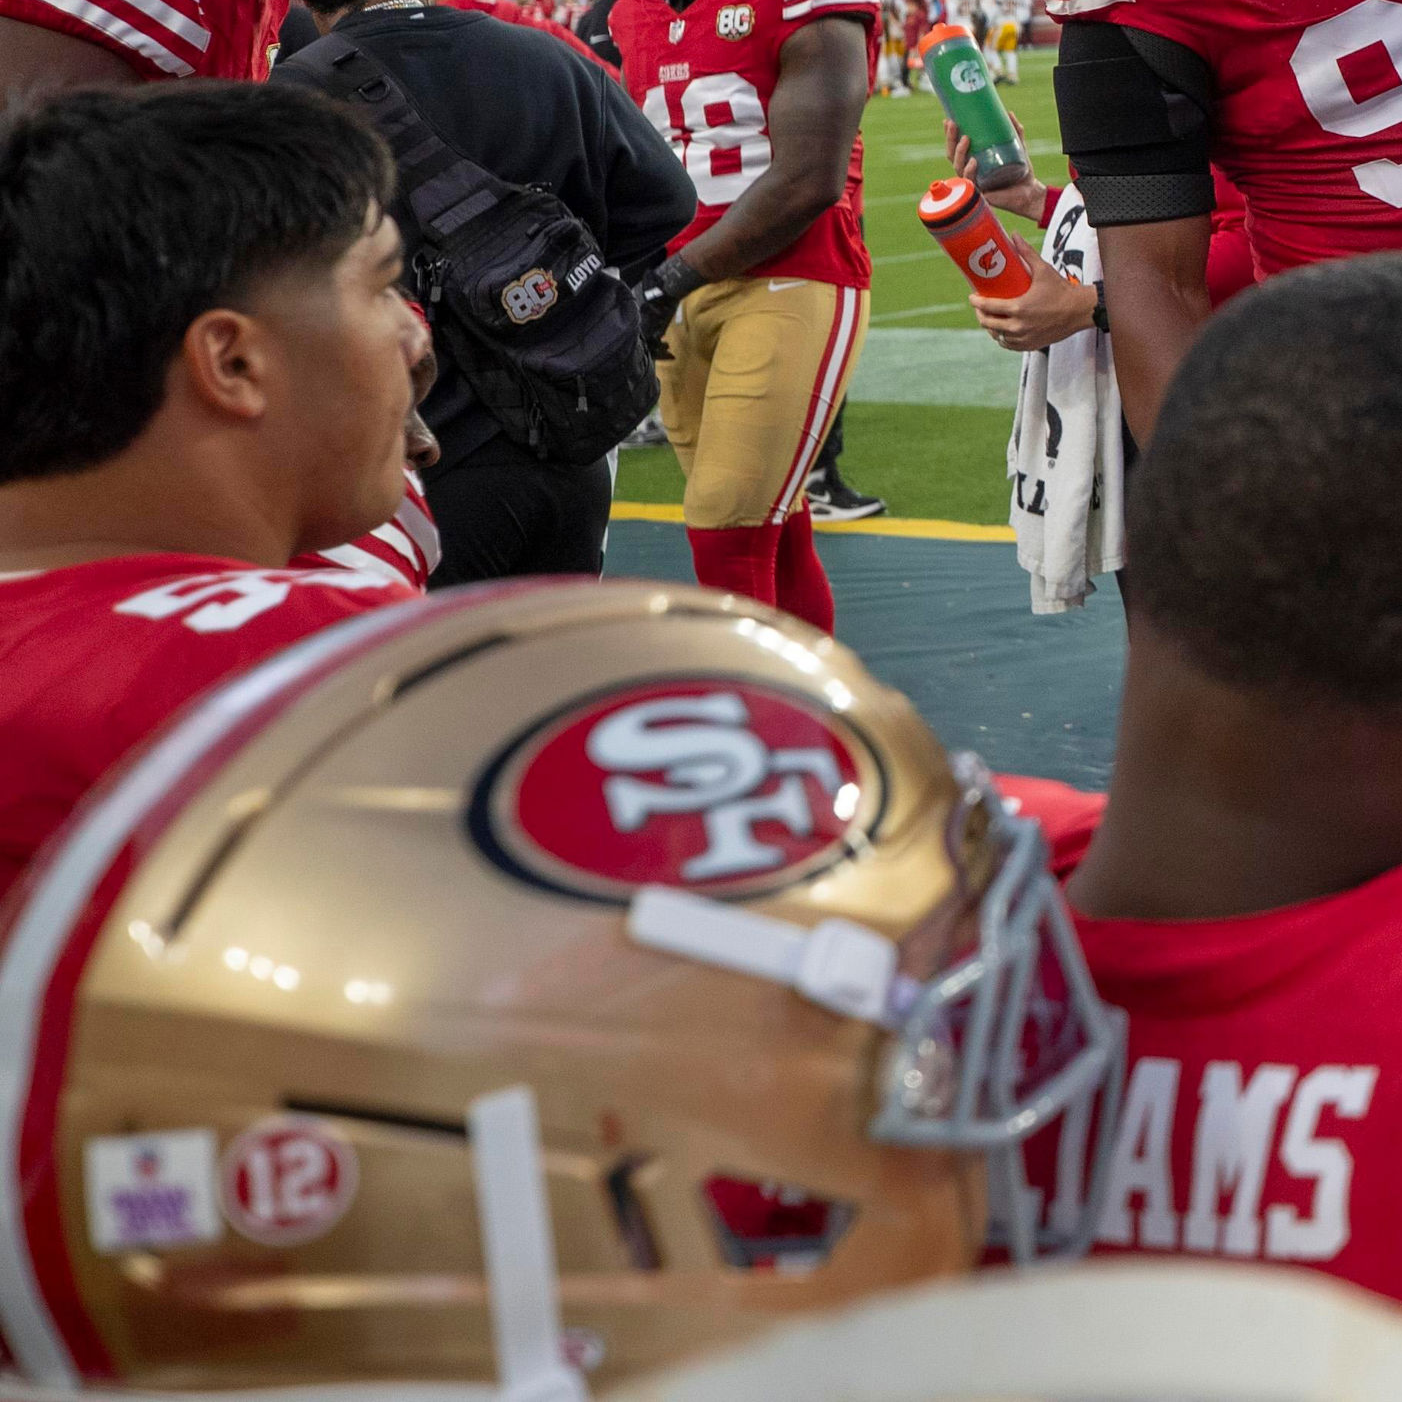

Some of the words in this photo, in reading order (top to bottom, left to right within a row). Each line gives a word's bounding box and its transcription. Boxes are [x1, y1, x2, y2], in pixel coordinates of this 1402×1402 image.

[950, 59, 986, 94] G
[565, 253, 602, 292] LLOYD
[968, 237, 1007, 279] G
[584, 693, 848, 882] SF
[252, 1143, 327, 1219] 12
